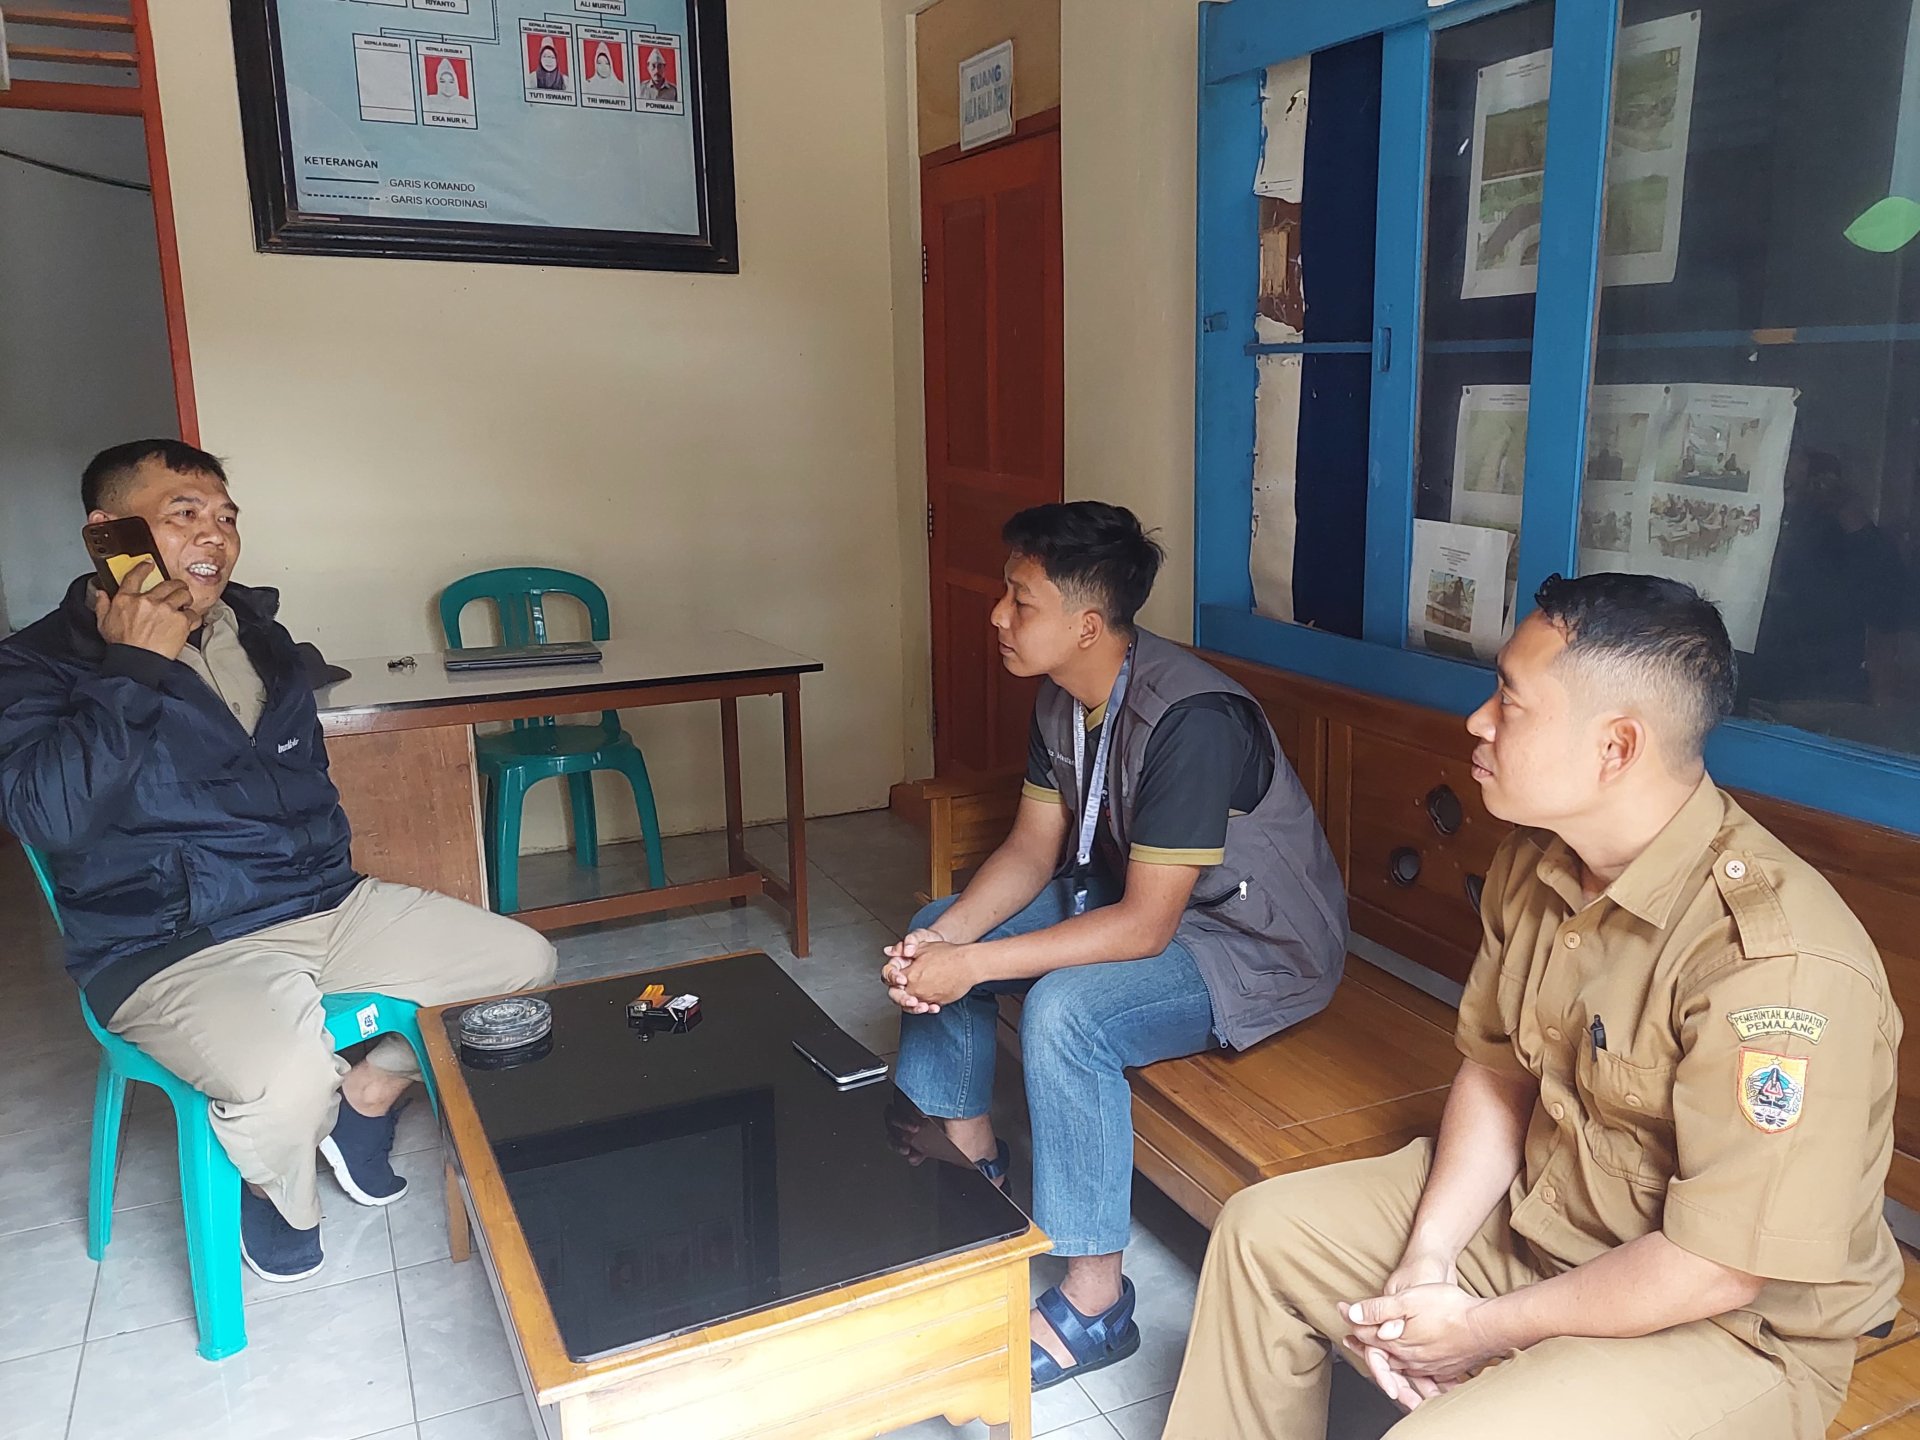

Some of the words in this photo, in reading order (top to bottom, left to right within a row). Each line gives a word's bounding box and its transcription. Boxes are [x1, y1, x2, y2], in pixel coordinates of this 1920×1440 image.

[592, 2, 621, 11] MURTAKI
[970, 64, 1002, 92] RUANG
[529, 91, 545, 99] TUTI
[545, 93, 572, 102] ISWANTI
[599, 98, 626, 107] WINARTI
[645, 102, 675, 110] PONIMAN
[446, 116, 461, 124] NUR
[303, 155, 379, 169] KETERANGAN
[389, 178, 422, 189] GARIS
[423, 181, 476, 192] KOMANDO
[390, 194, 423, 205] GARIS
[425, 196, 488, 209] KOORDINASI
[1734, 1010, 1782, 1026] PEMERINTAH
[1784, 1010, 1824, 1028] KABUPATEN
[1746, 1019, 1815, 1036] PEMALANG
